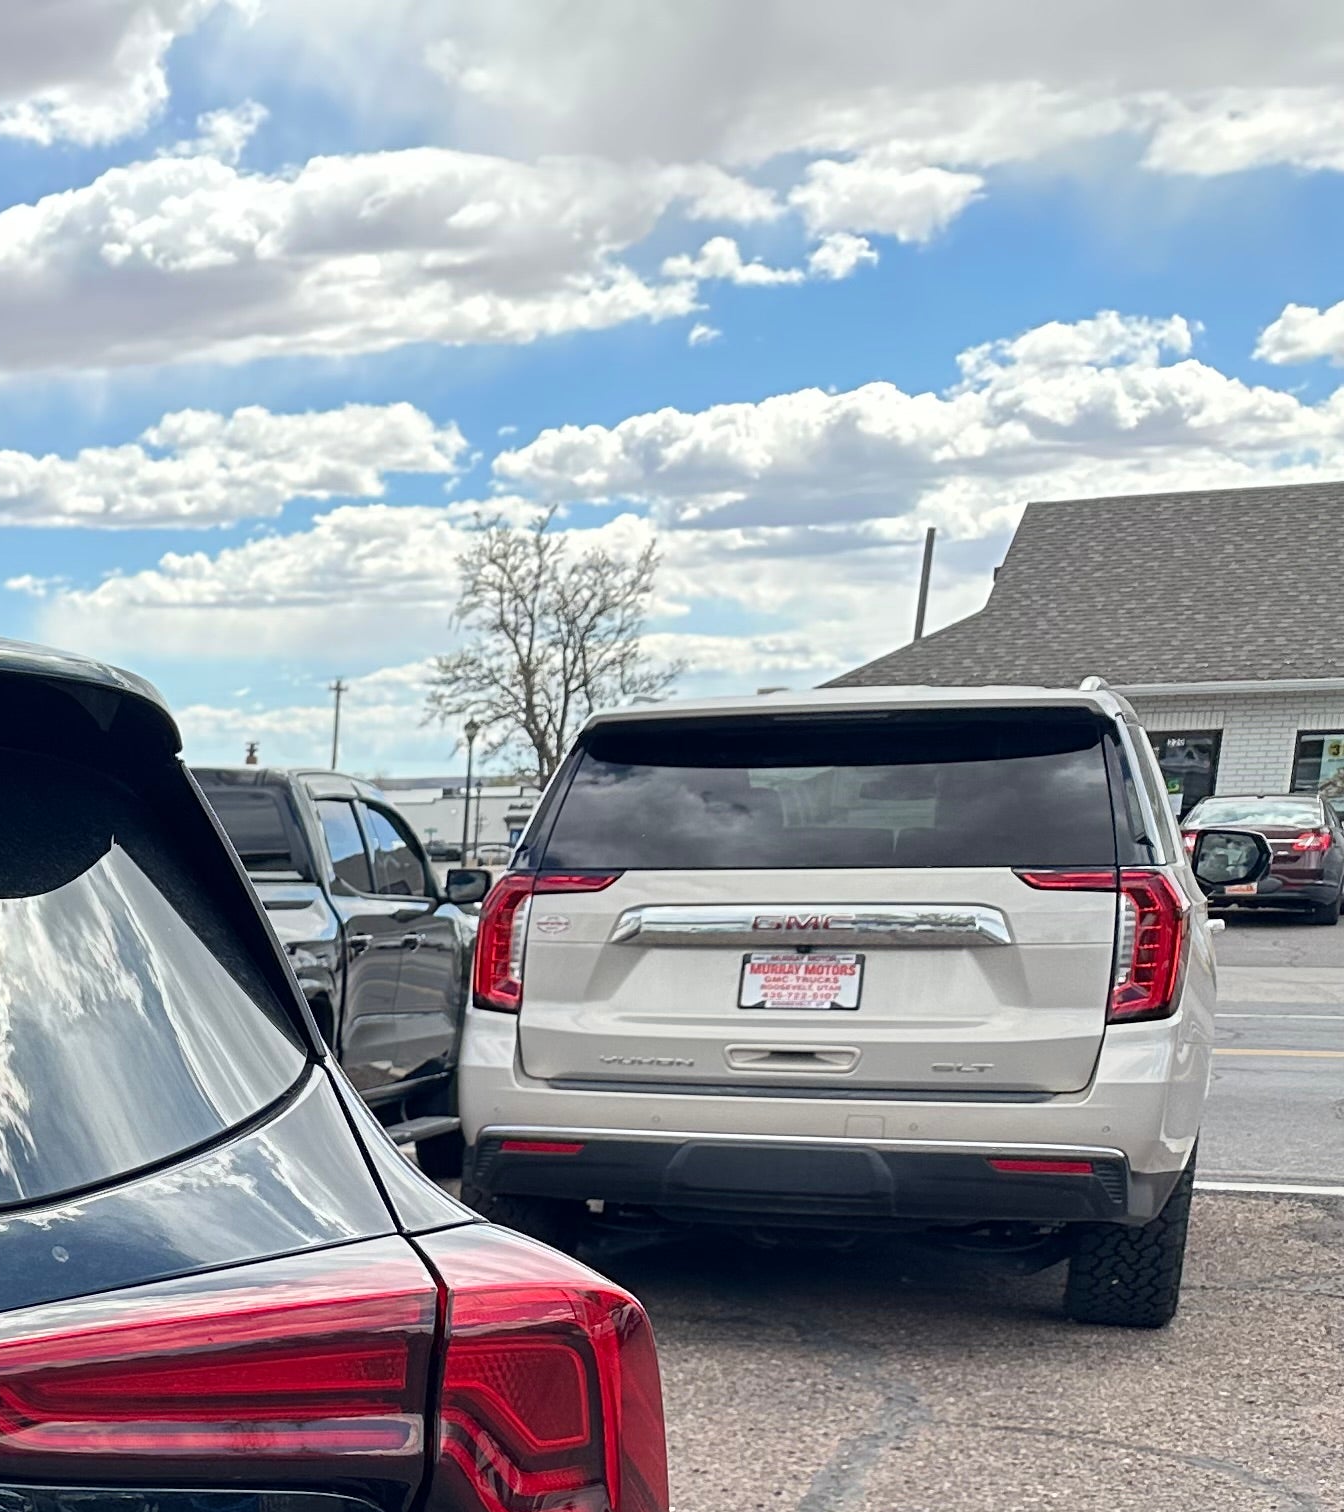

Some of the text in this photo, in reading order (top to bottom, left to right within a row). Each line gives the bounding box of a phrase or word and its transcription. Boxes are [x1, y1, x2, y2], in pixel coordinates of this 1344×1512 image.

[751, 913, 856, 931] GMC
[749, 964, 856, 976] MURRAY MOTORS
